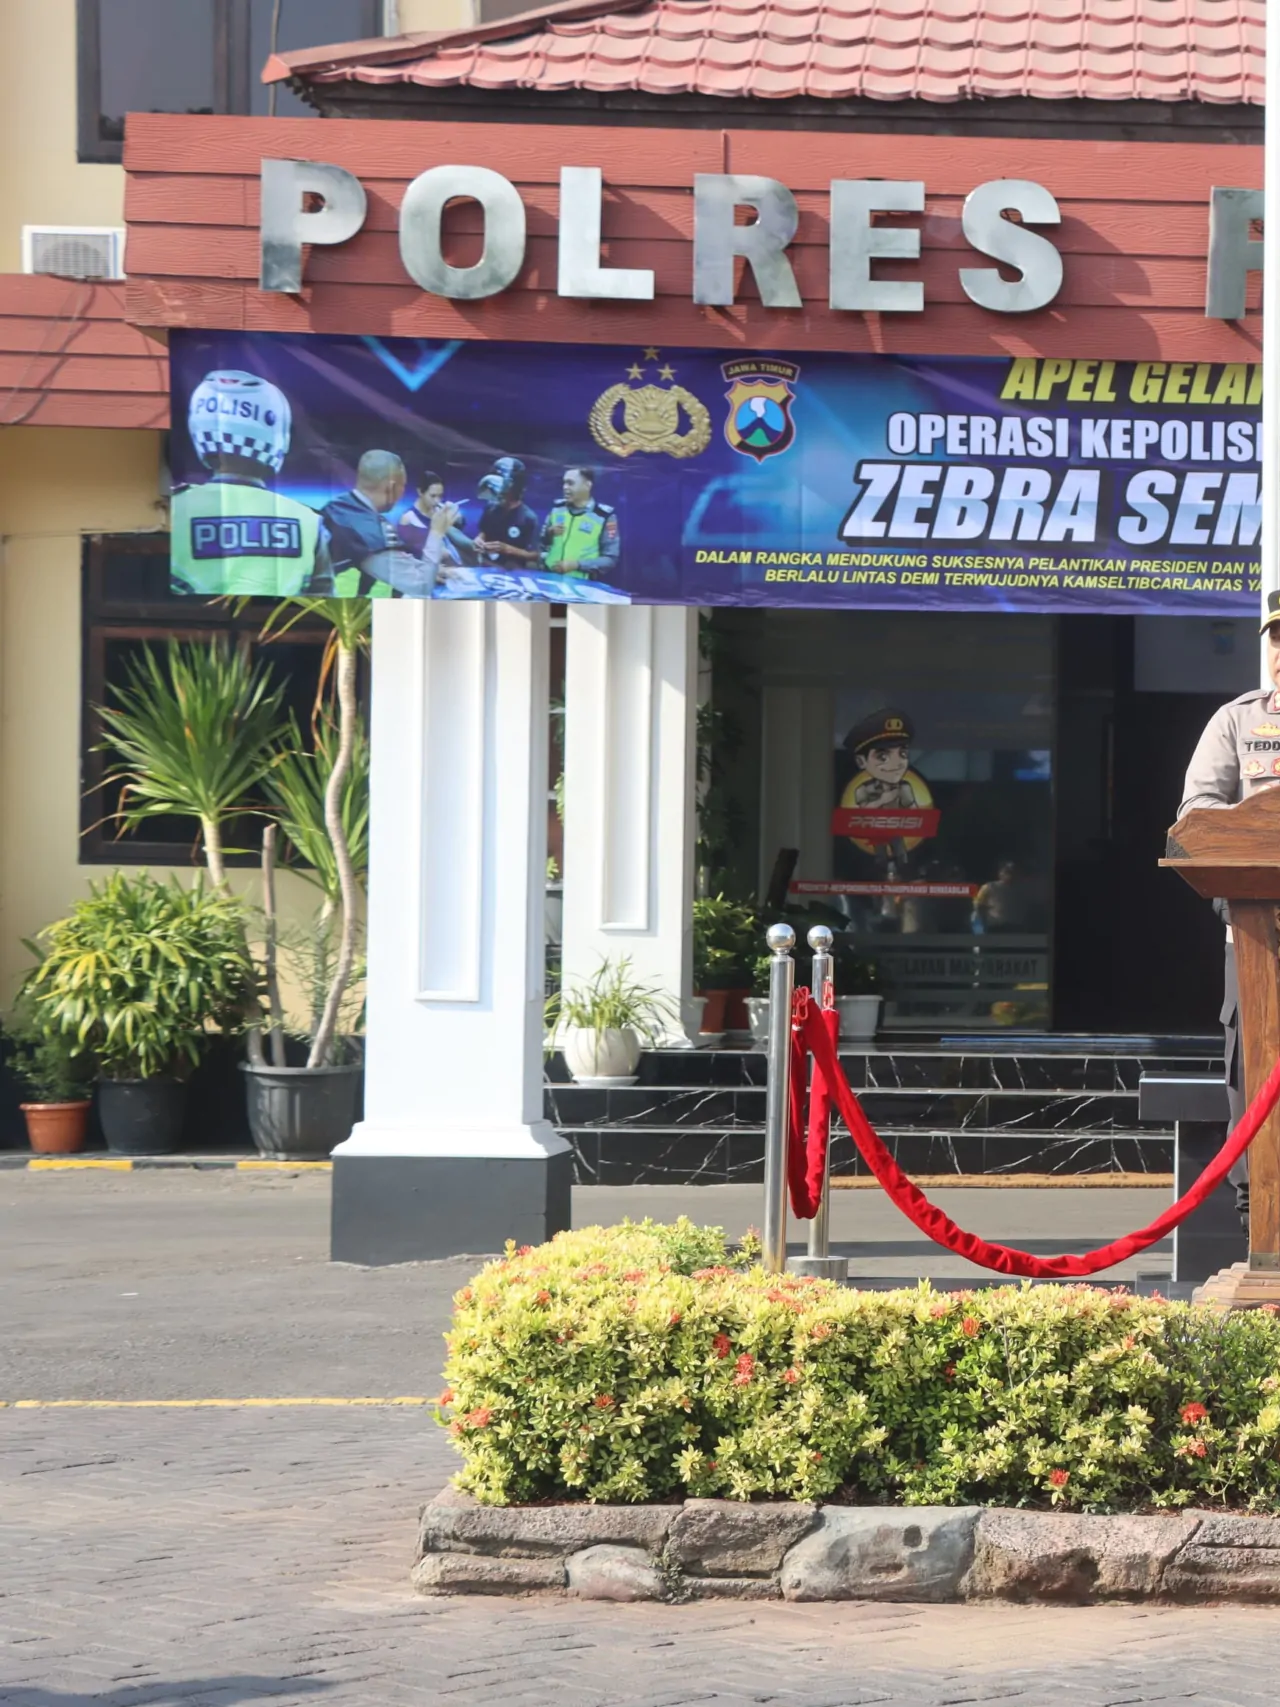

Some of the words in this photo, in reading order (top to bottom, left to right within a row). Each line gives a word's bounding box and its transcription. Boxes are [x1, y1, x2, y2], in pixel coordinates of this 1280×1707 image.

[258, 157, 1064, 313] POLRES
[728, 363, 758, 375] JAWA
[760, 363, 794, 377] TIMUR
[1001, 357, 1117, 402] APEL
[195, 396, 260, 422] POLISI
[888, 412, 1069, 458] OPERASI
[842, 463, 1101, 544] ZEBRA
[194, 522, 299, 551] POLISI
[695, 550, 751, 564] DALAM
[756, 552, 823, 566] RANGKA
[827, 553, 927, 568] MENDUKUNG
[932, 556, 1025, 570] SUKSESNYA
[1029, 558, 1127, 572] PELANTIKAN
[1130, 560, 1208, 574] PRESIDEN
[1211, 562, 1245, 575] DAN
[765, 569, 838, 583] BERLALU
[843, 570, 897, 584] LINTAS
[900, 572, 939, 585] DEMI
[945, 573, 1059, 588] TERWUJUDNYA
[1063, 575, 1243, 591] KAMSELTIBCARLANTAS
[849, 816, 924, 829] PRESISI
